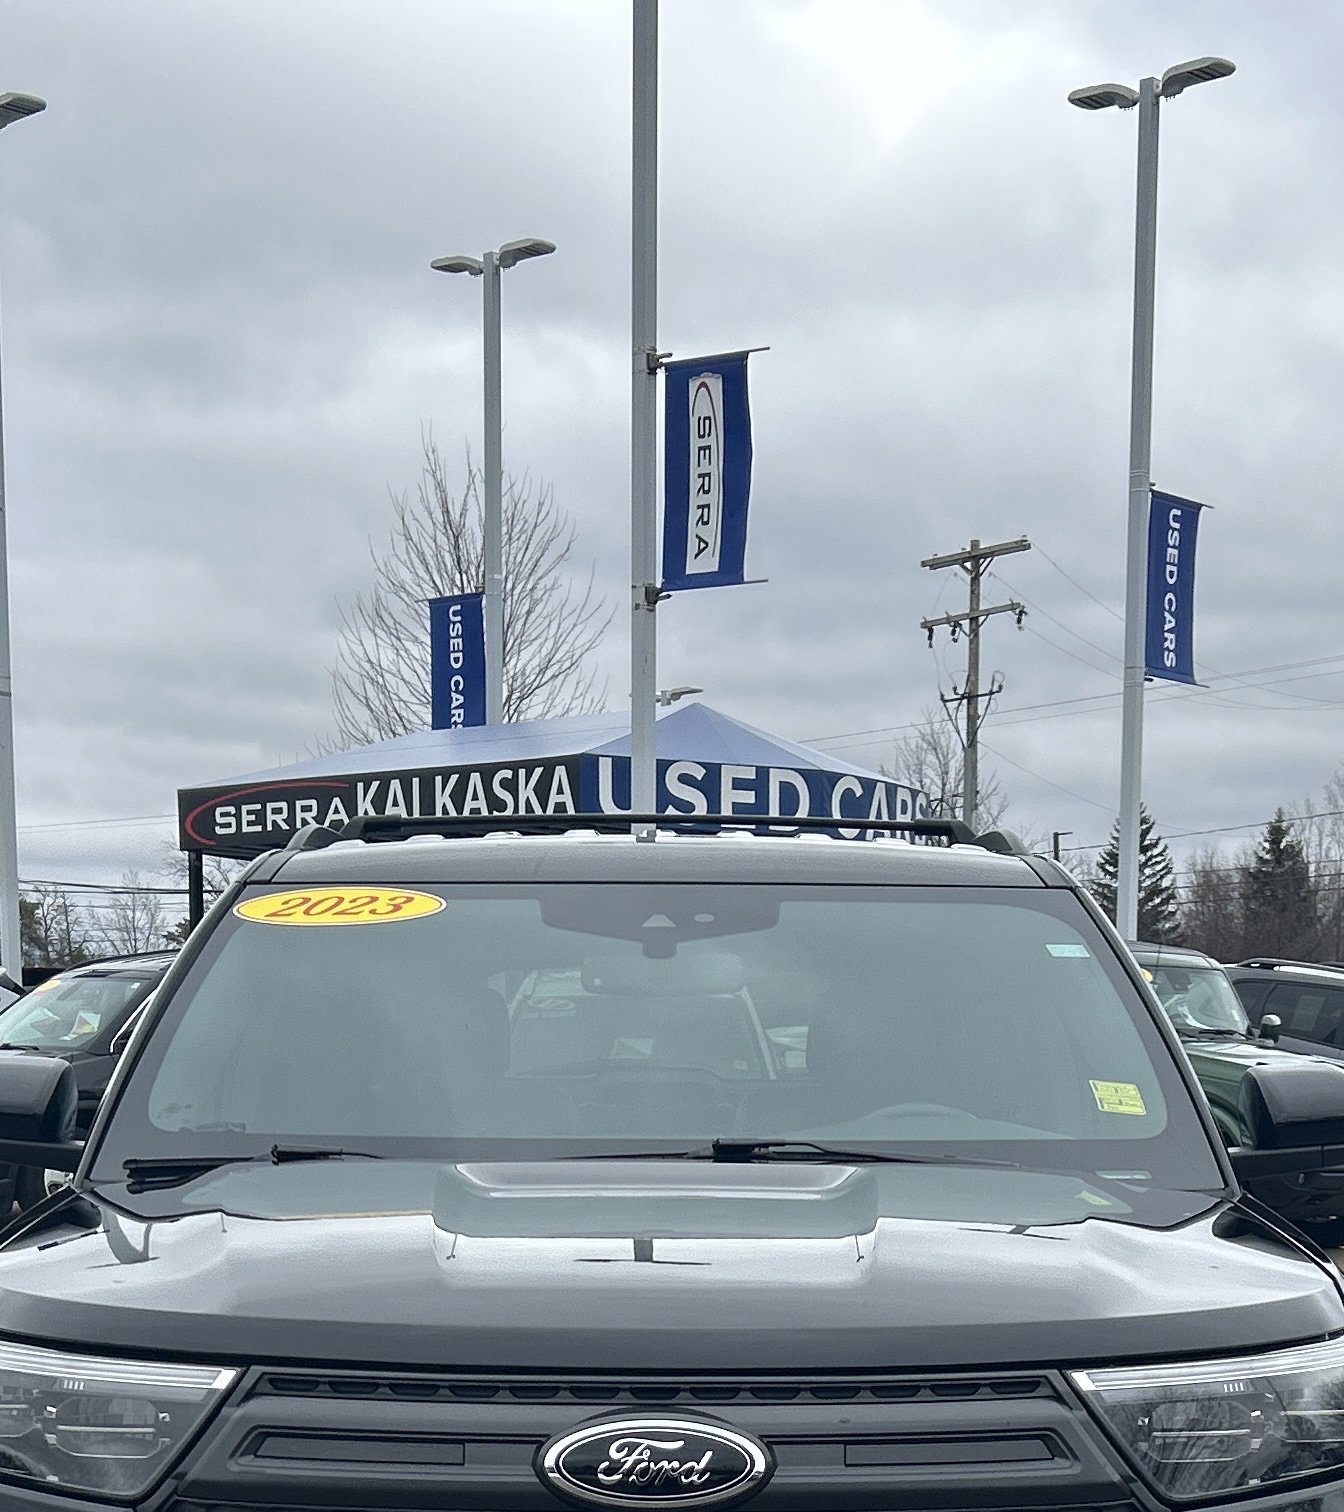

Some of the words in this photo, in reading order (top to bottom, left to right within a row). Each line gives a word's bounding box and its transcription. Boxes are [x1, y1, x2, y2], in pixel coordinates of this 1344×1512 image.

[693, 415, 712, 561] SERRA
[1165, 508, 1182, 585] USED
[448, 604, 463, 669] USED
[1163, 592, 1177, 669] CARS
[214, 796, 351, 835] SERRA
[598, 756, 811, 832] USED
[263, 895, 415, 918] 2023
[596, 1437, 714, 1486] Ford
